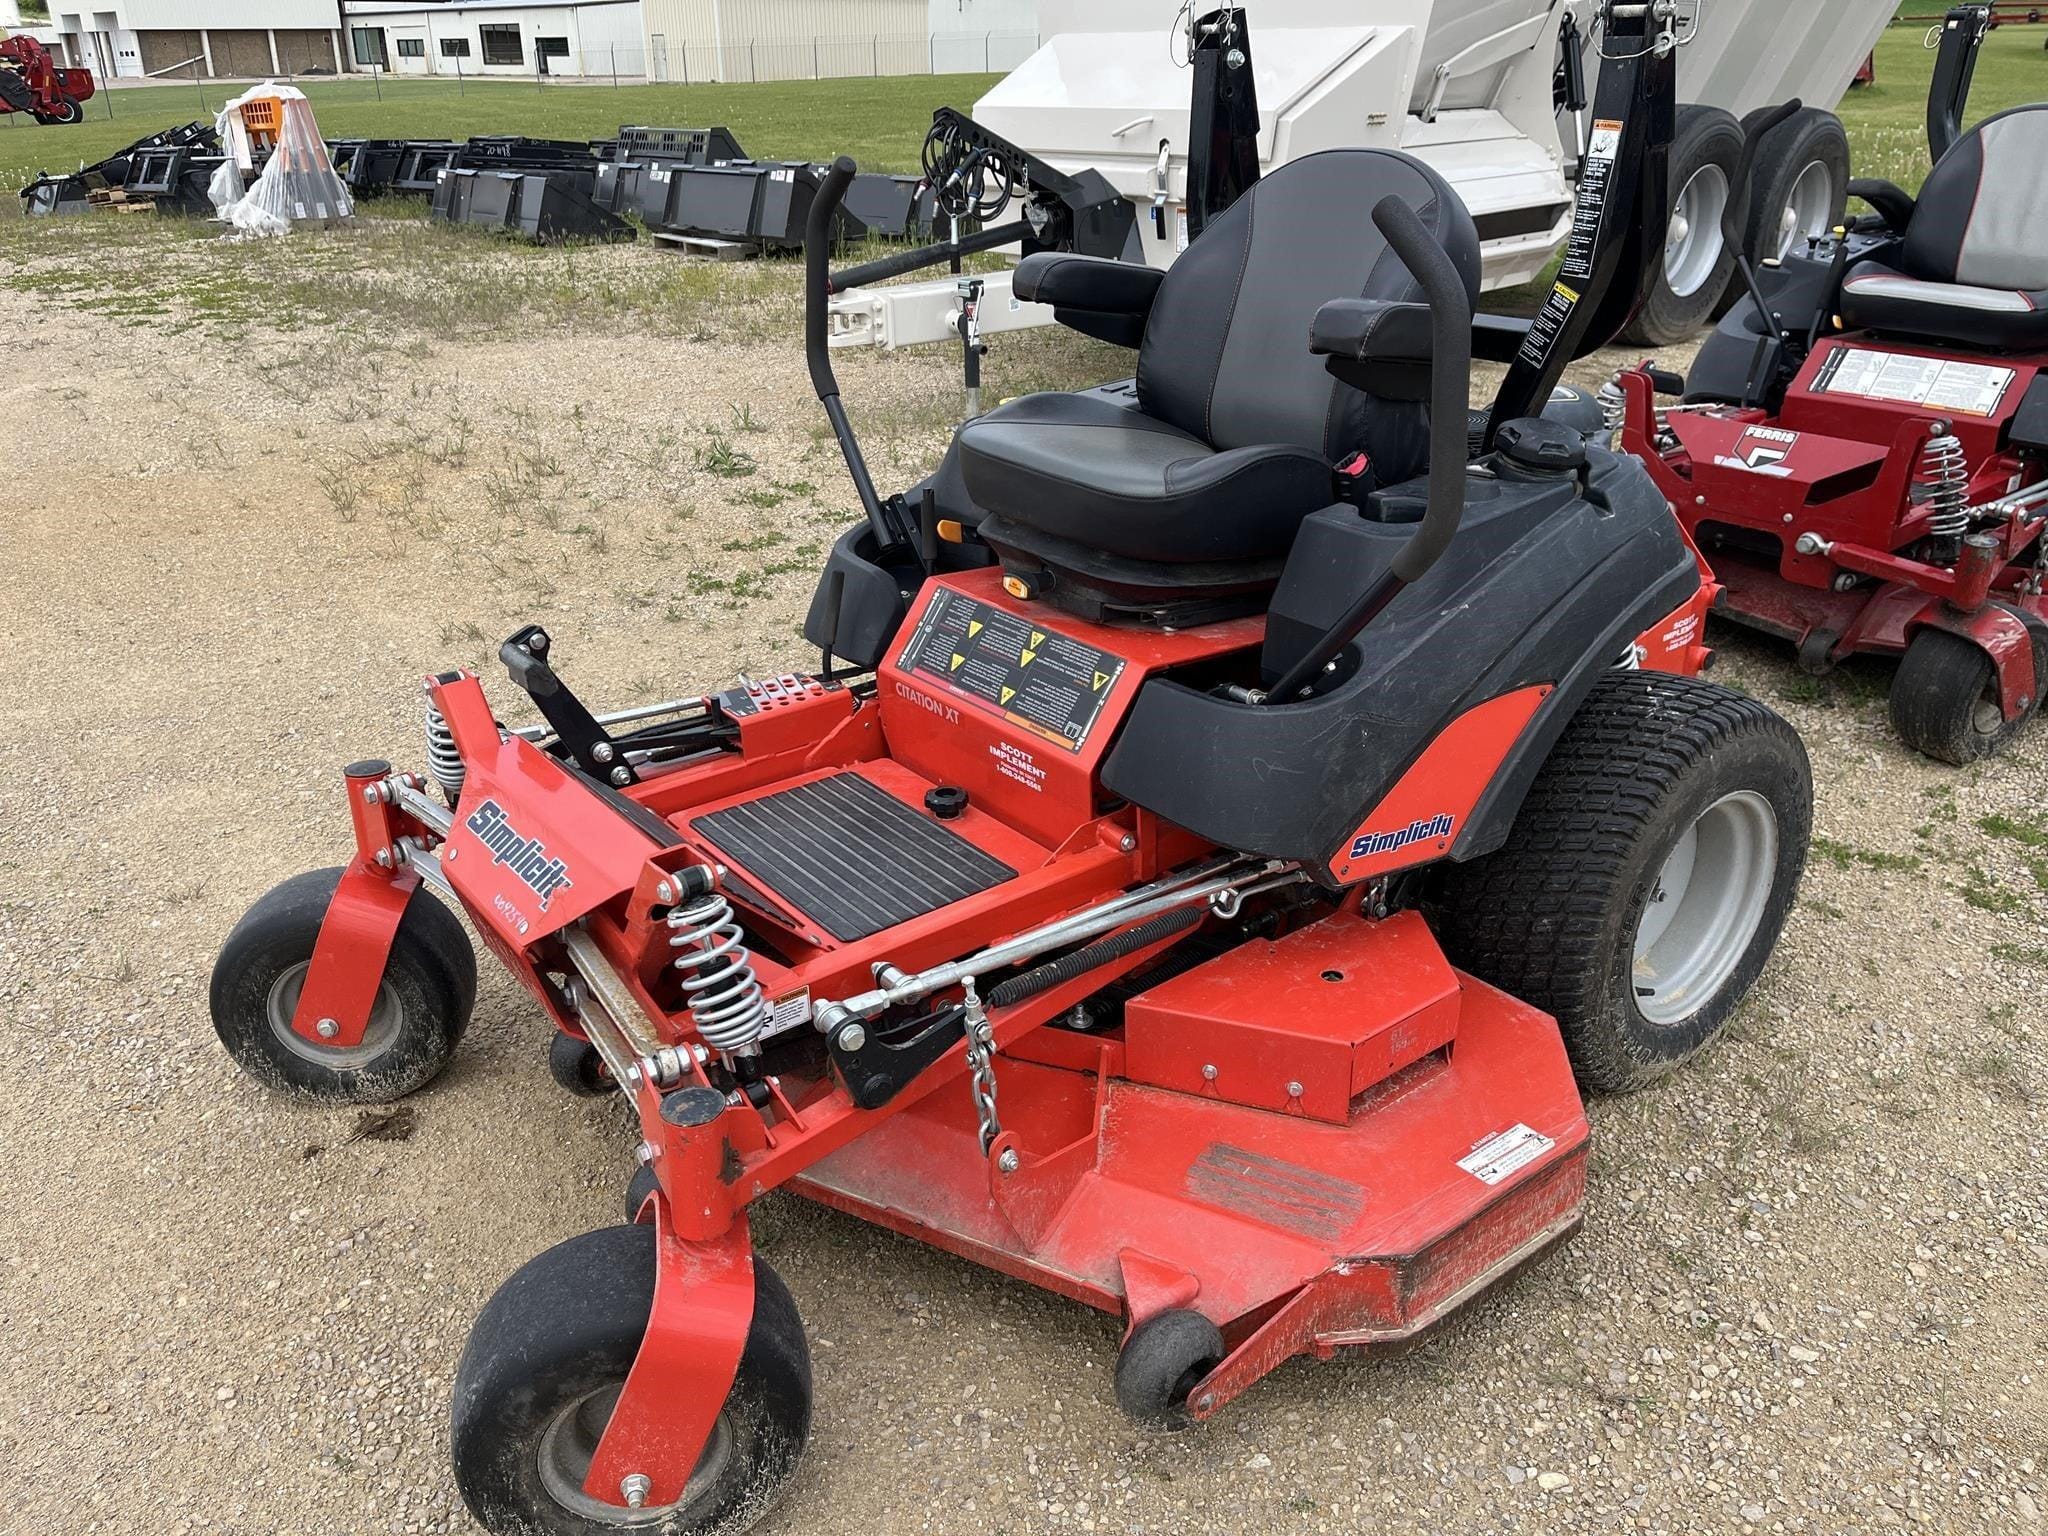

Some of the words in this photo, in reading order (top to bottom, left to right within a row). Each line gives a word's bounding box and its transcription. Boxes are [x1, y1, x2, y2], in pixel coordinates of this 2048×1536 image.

[1557, 285, 1578, 300] CAUTION
[1745, 426, 1796, 443] FERRIS
[895, 681, 943, 717] CITATION
[945, 706, 960, 725] XT
[989, 745, 1047, 780] IMPLEMENT
[1000, 741, 1034, 764] SCOTT
[1349, 813, 1455, 859] Simplicity
